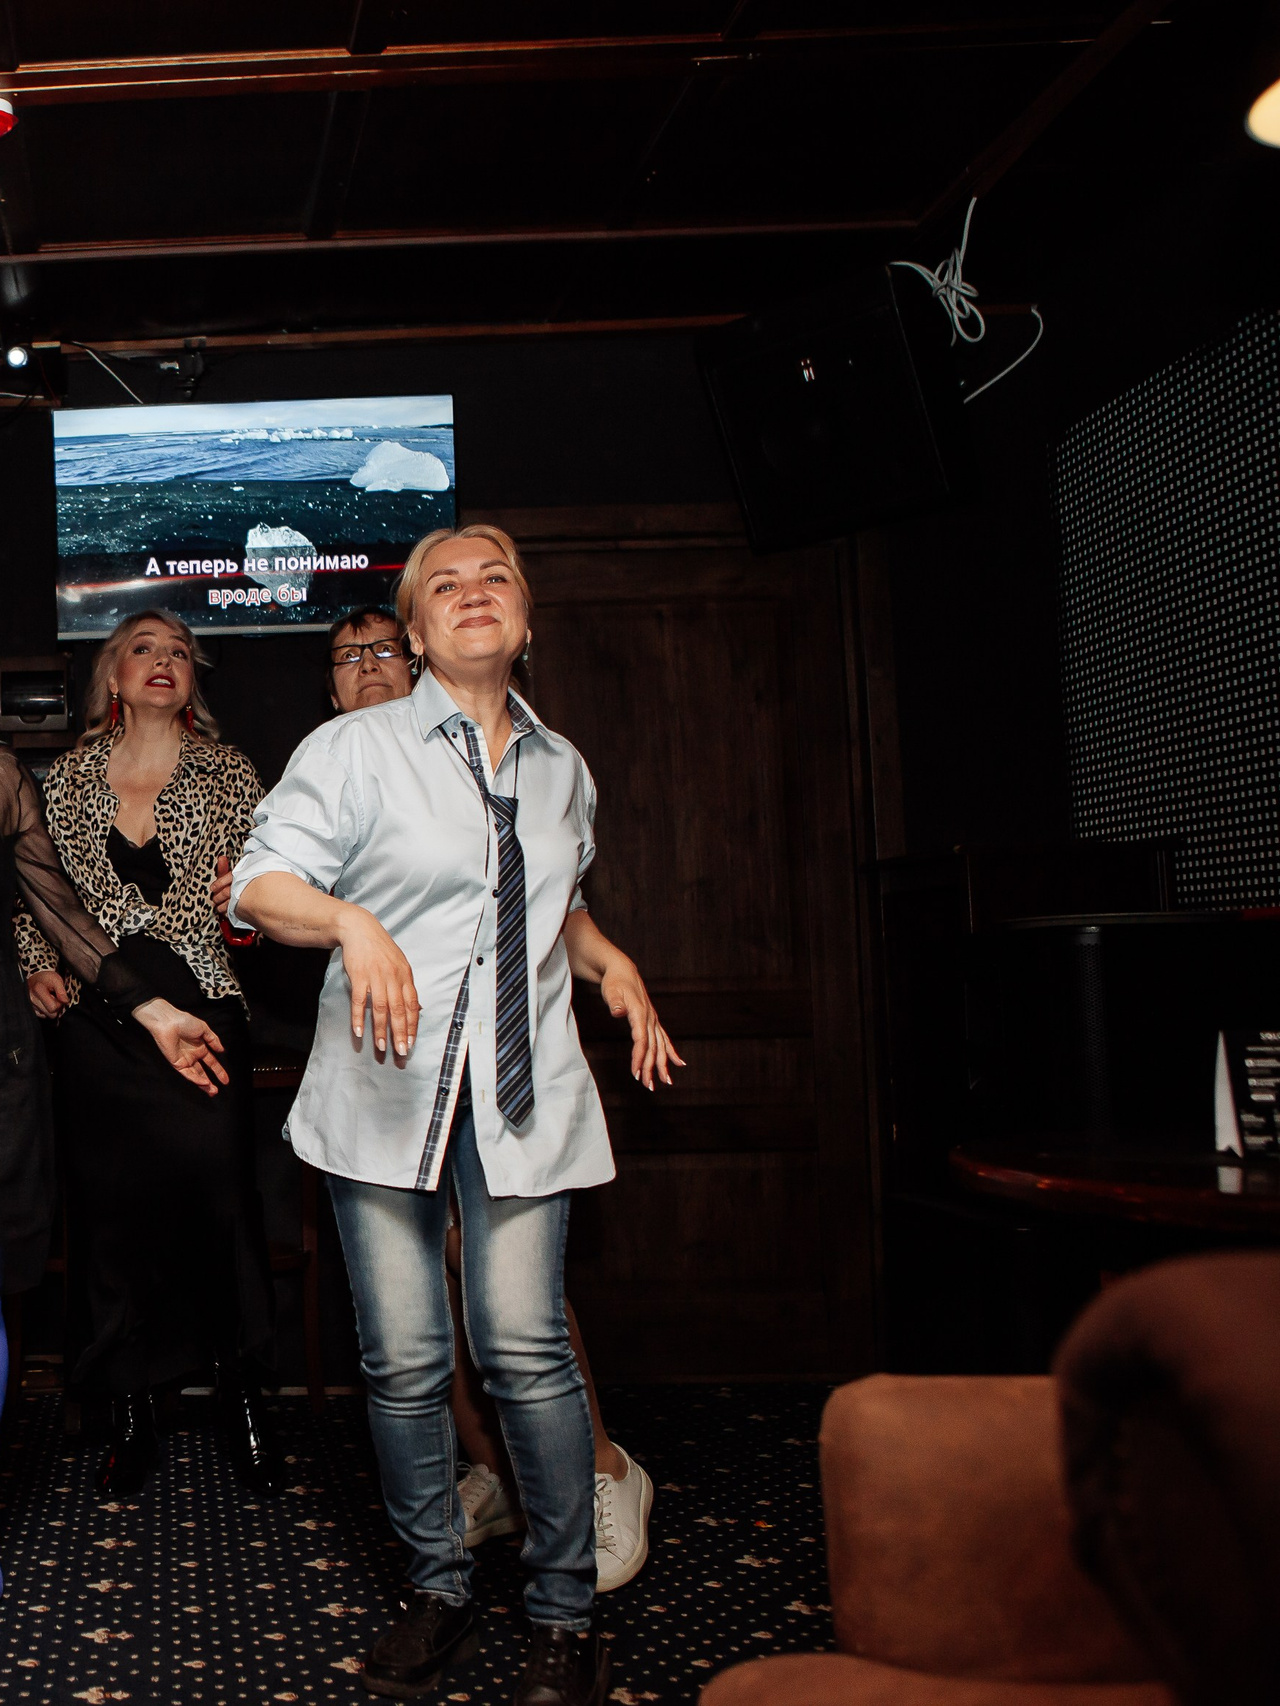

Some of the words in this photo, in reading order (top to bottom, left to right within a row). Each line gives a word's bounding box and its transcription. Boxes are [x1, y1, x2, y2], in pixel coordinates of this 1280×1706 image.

[145, 557, 161, 576] А
[166, 558, 239, 577] теперь
[244, 557, 268, 572] не
[274, 554, 369, 571] понимаю
[208, 587, 271, 608] вроде
[277, 583, 307, 602] бы
